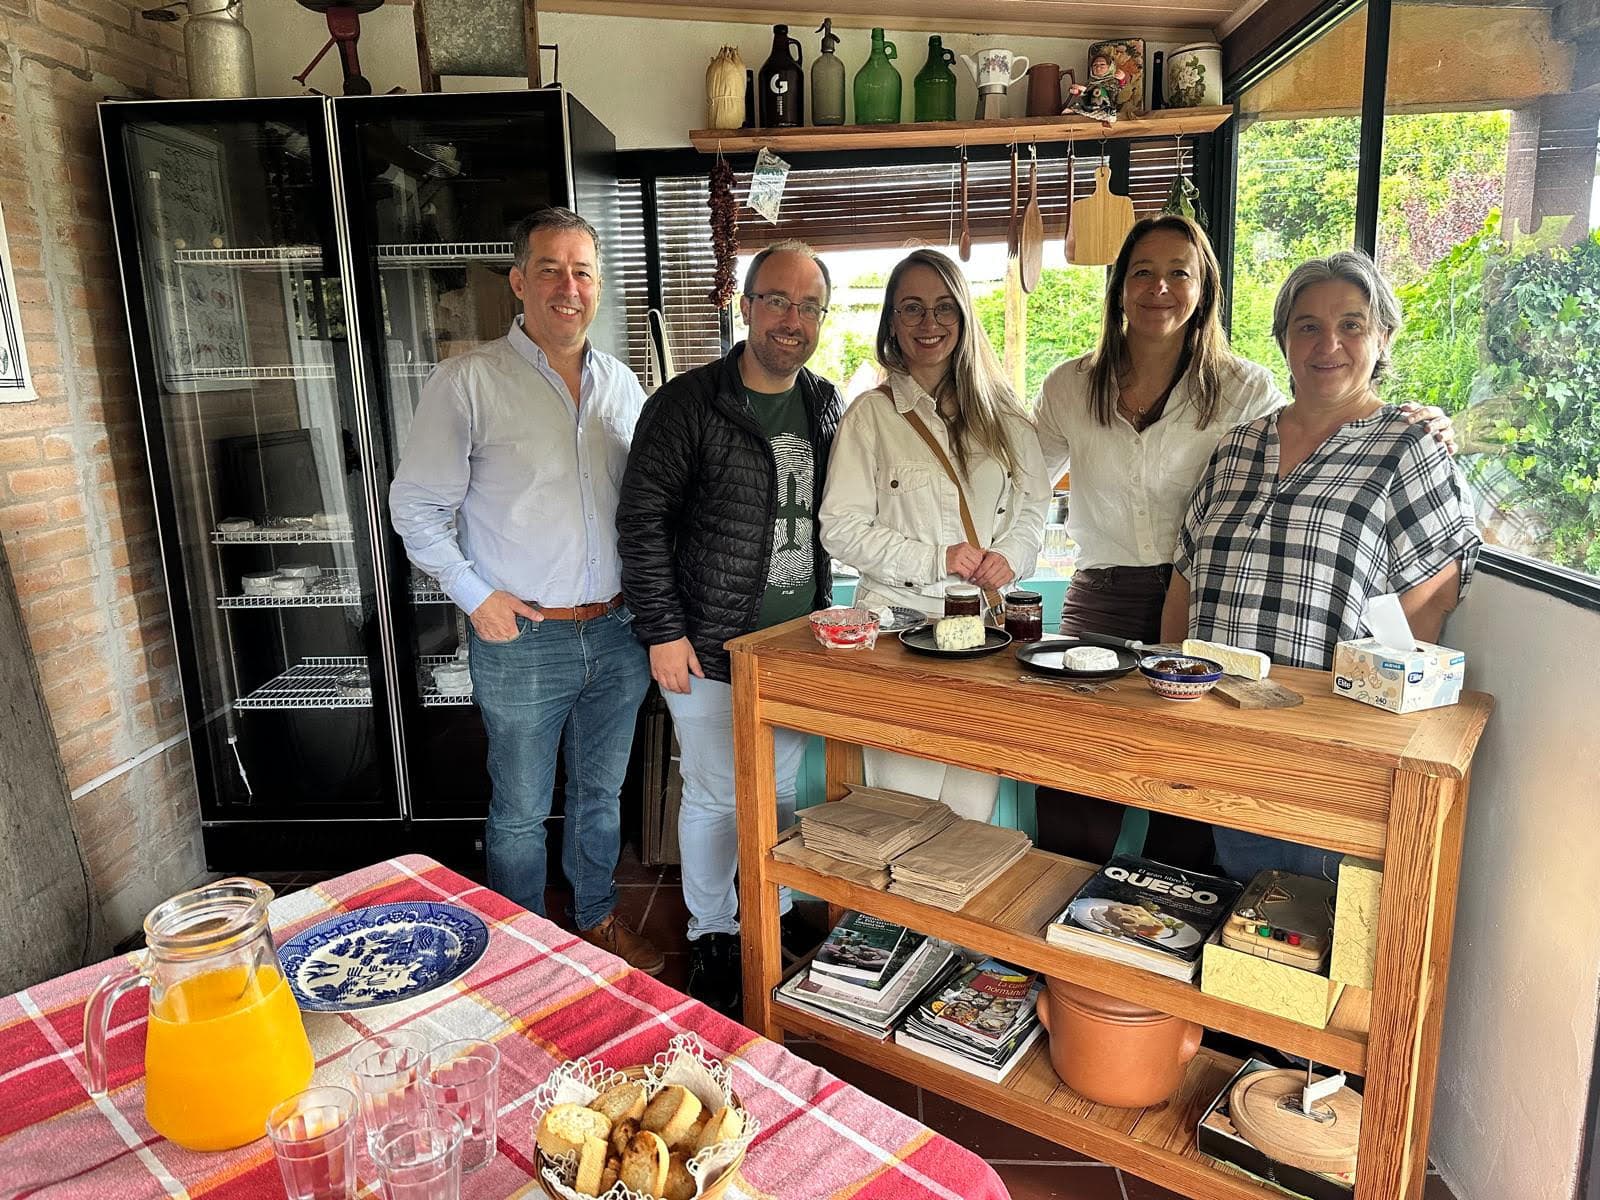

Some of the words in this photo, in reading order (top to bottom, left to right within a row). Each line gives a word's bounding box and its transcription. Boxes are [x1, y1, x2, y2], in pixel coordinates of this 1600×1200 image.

[770, 73, 788, 94] G
[1337, 678, 1351, 689] Elite
[1375, 695, 1387, 705] 240
[1104, 866, 1218, 905] QUESO
